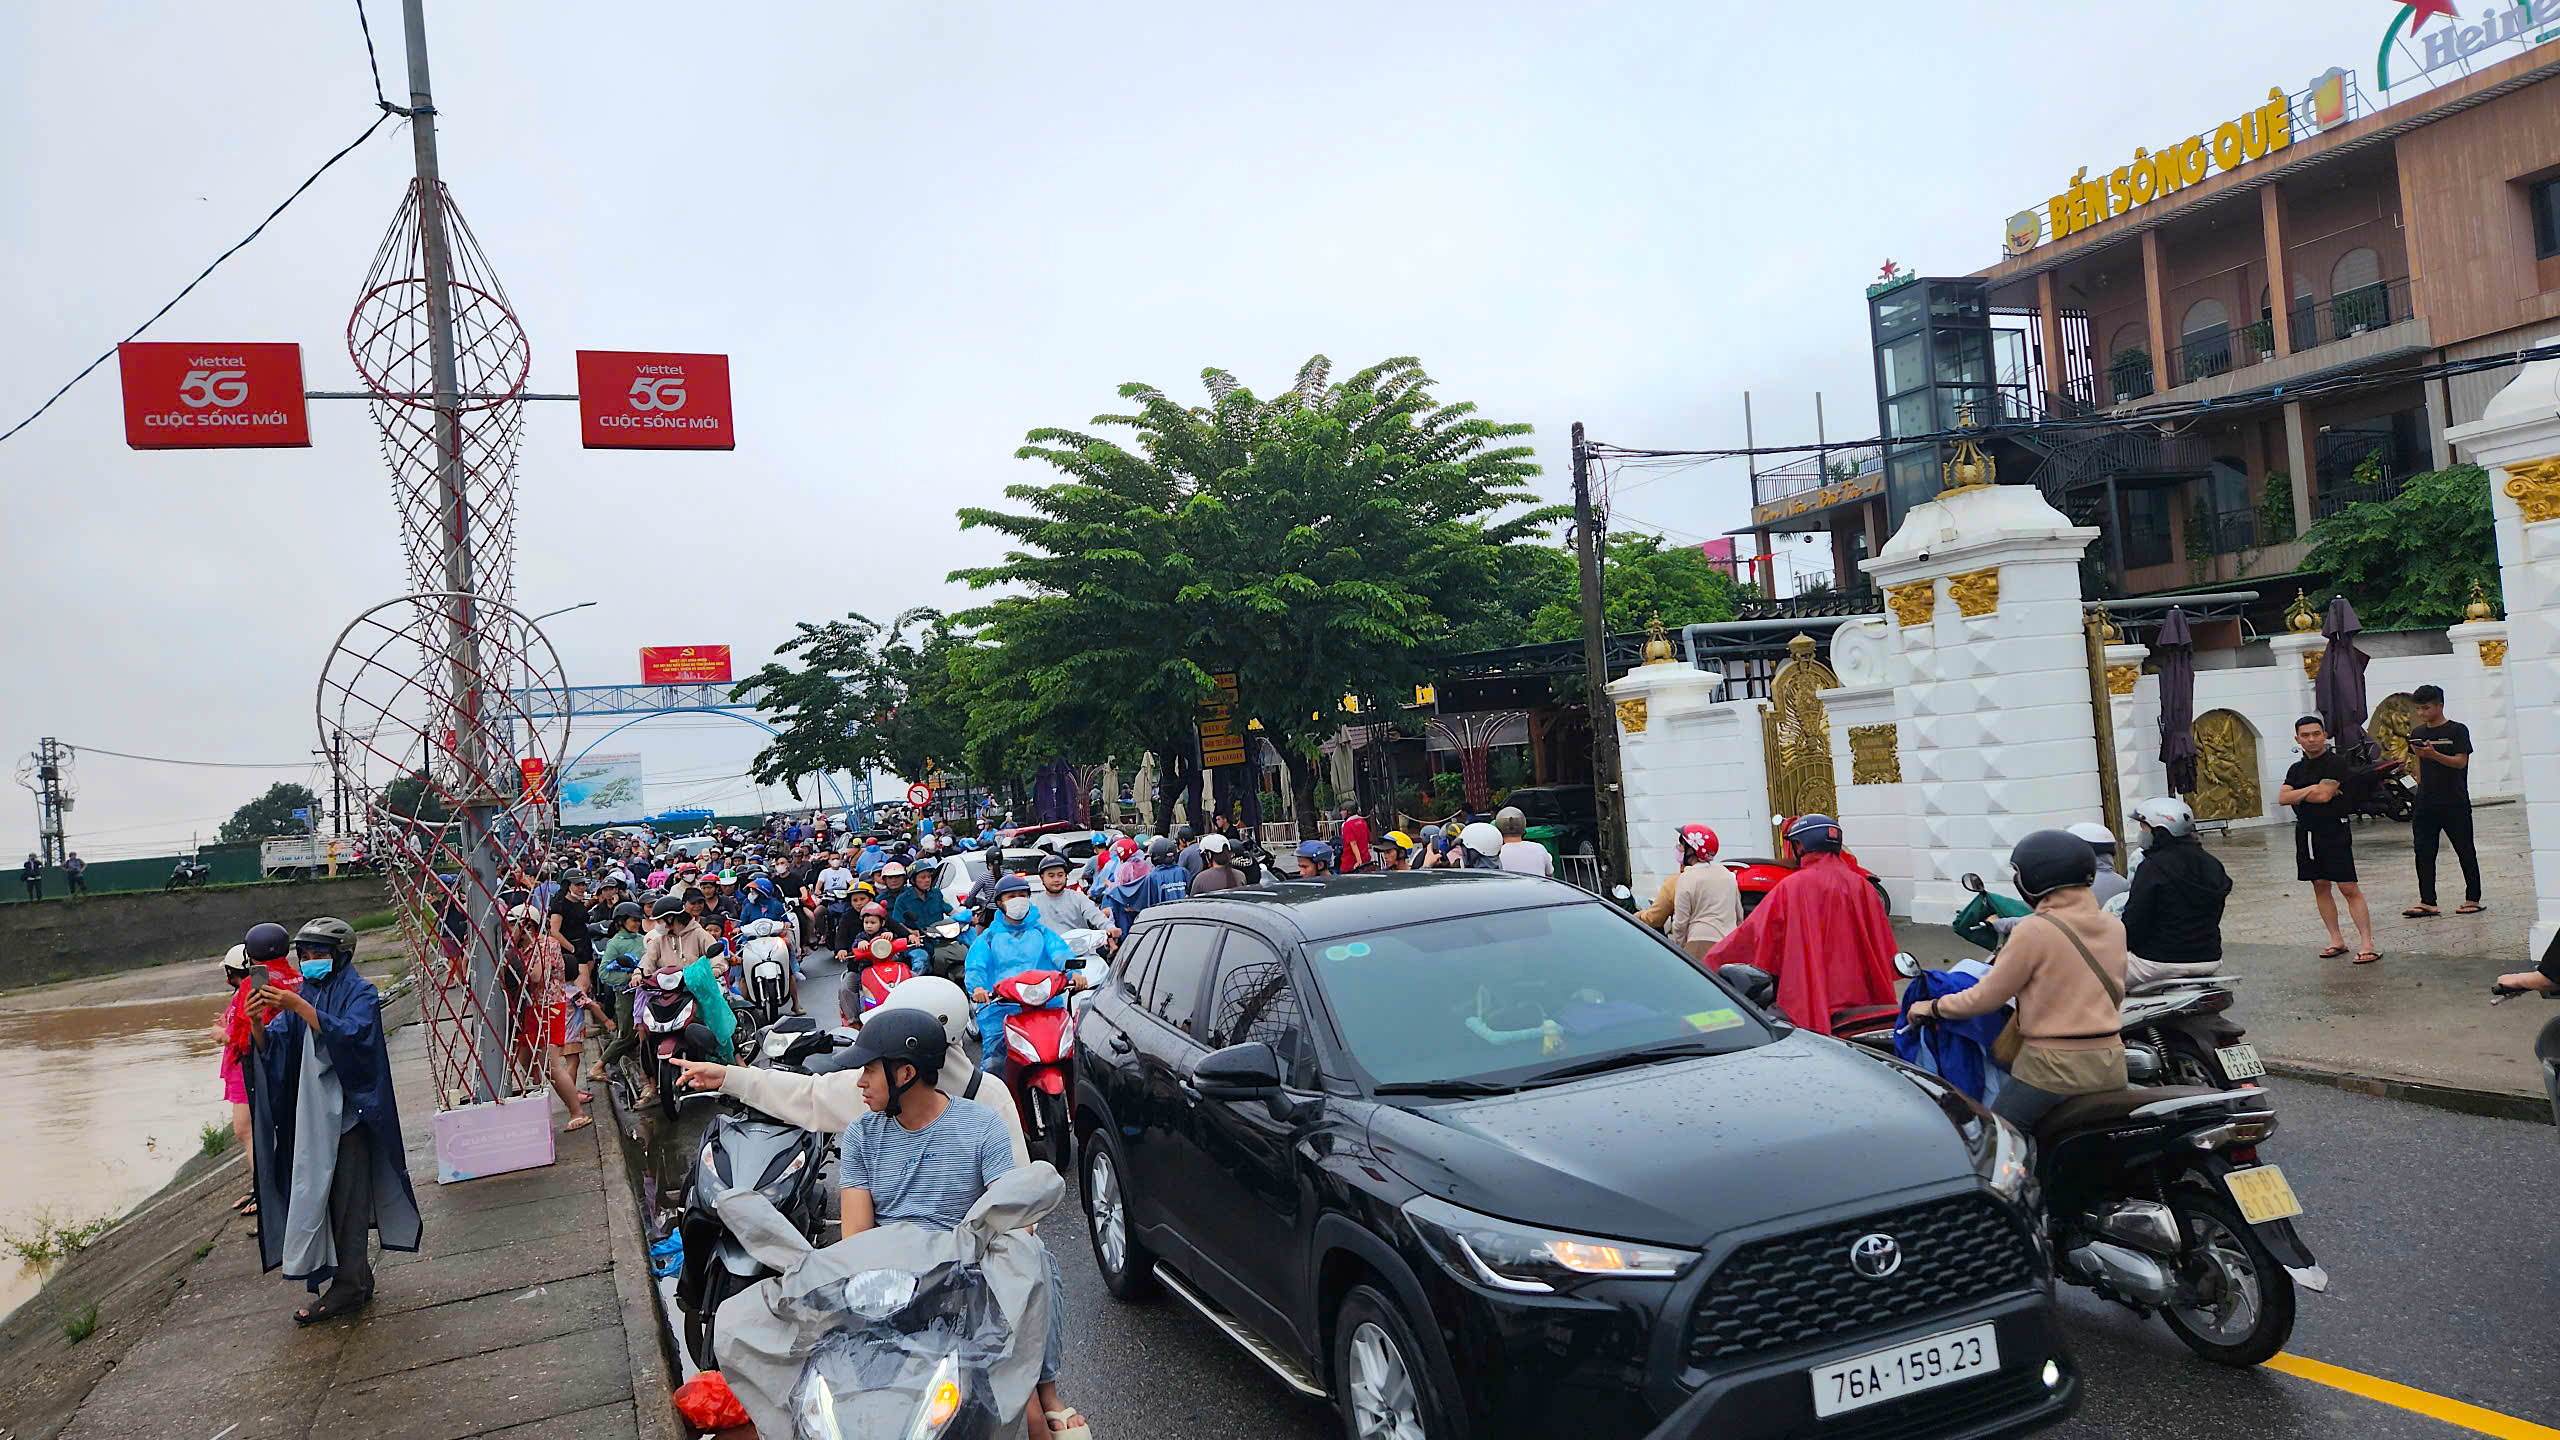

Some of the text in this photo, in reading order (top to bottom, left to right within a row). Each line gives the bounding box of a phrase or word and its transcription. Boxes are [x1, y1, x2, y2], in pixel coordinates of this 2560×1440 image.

[2049, 86, 2291, 241] BẾN SÔNG QUÊ
[189, 356, 246, 367] viettel
[637, 364, 684, 375] viettel
[180, 370, 249, 408] 5G
[629, 377, 687, 411] 5G
[145, 408, 288, 428] CUỘC SỐNG MỚI
[600, 412, 719, 429] CUỘC SỐNG MỚI
[2222, 1047, 2251, 1063] 76-H1
[2227, 1061, 2262, 1078] 133.69
[1831, 1337, 1982, 1403] 76A-159.23
